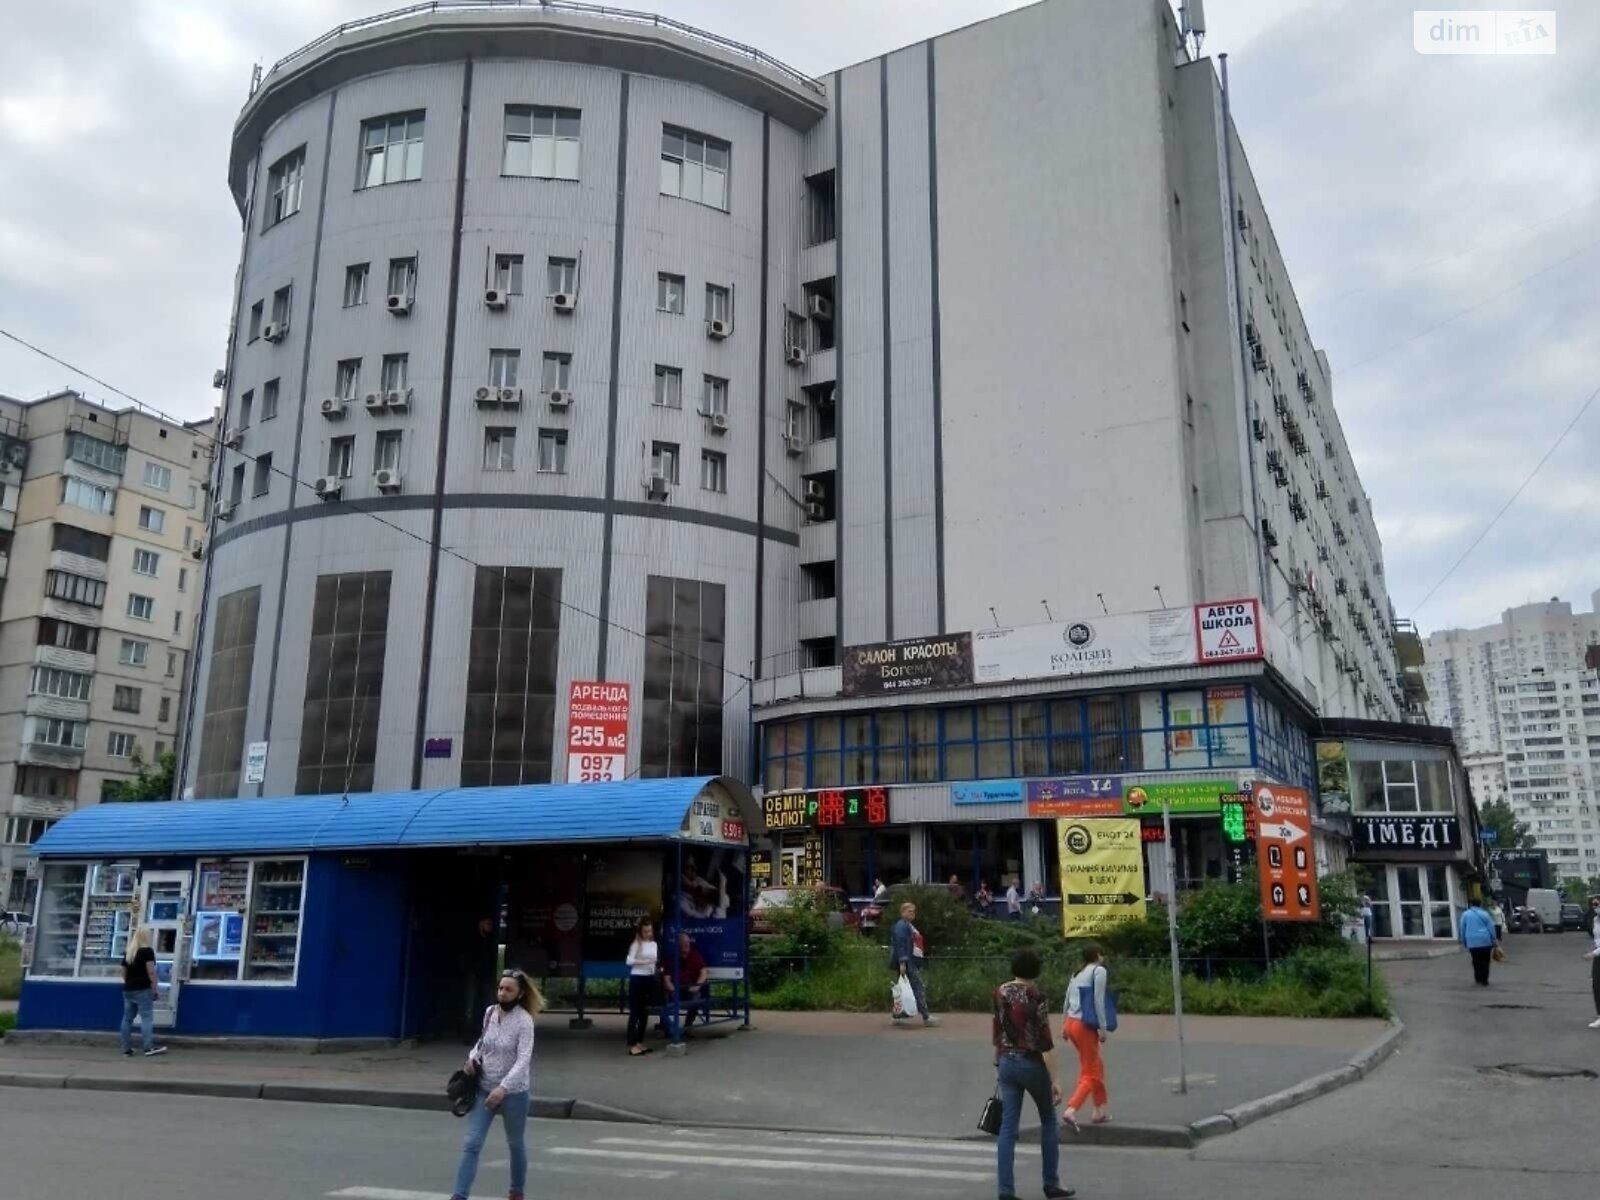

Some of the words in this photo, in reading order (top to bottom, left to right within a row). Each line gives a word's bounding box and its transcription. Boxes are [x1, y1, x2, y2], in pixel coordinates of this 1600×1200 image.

[1207, 604, 1245, 618] АВТО
[1202, 617, 1254, 630] ШКОЛА
[858, 648, 896, 665] САЛОН
[903, 641, 958, 661] КРАСОТЫ
[572, 685, 628, 702] АРЕНДА
[571, 711, 627, 721] ПОМЕЩЕНИЯ
[570, 725, 604, 747] 255
[607, 733, 625, 747] м2
[581, 755, 613, 771] 097
[766, 794, 806, 812] ОБМІН
[766, 811, 806, 828] ВАЛЮТ
[1367, 823, 1451, 849] ІМЕДІ
[589, 906, 651, 918] НАЙБІЛЬША
[589, 918, 632, 929] МЕРЕЖА
